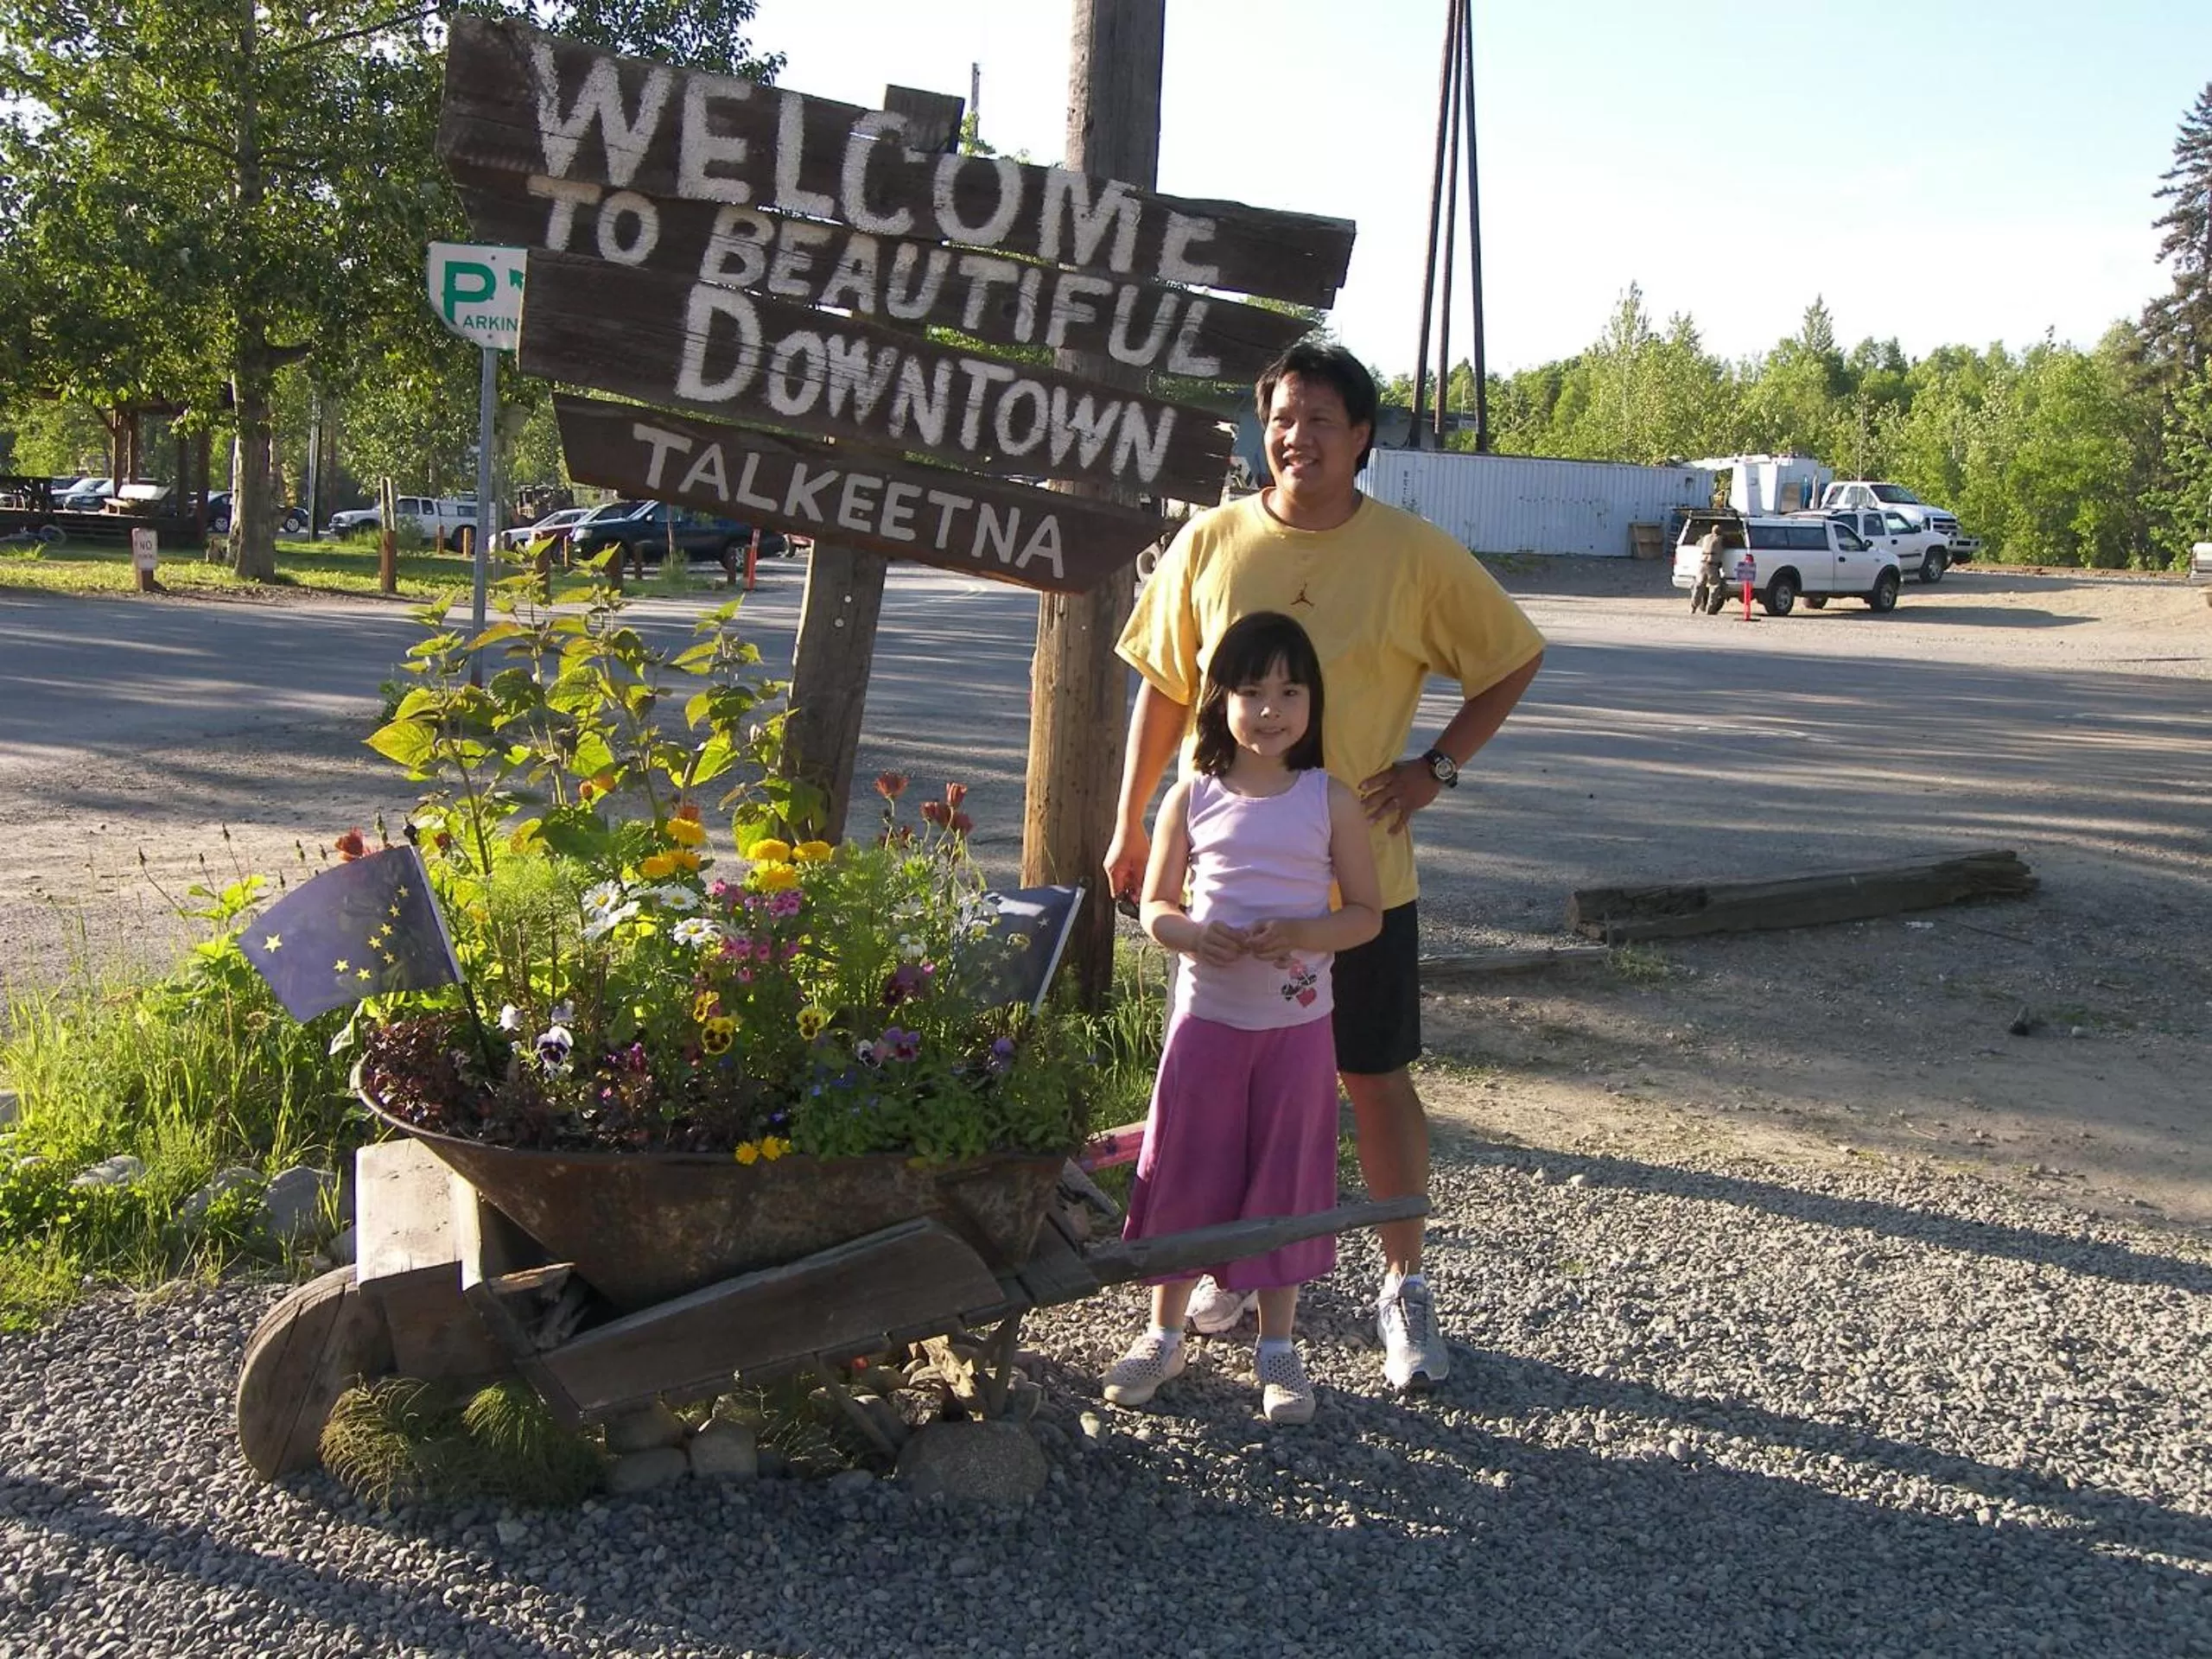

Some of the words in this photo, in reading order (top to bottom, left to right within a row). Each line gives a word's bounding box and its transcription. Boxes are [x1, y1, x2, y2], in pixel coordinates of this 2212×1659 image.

[531, 41, 1220, 284] WELCOME
[463, 315, 518, 332] ARKIN
[526, 174, 660, 266] TO
[699, 205, 1220, 378] BEAUTIFUL
[676, 283, 1179, 483] DOWNTOWN
[633, 423, 1065, 579] TALKEETNA
